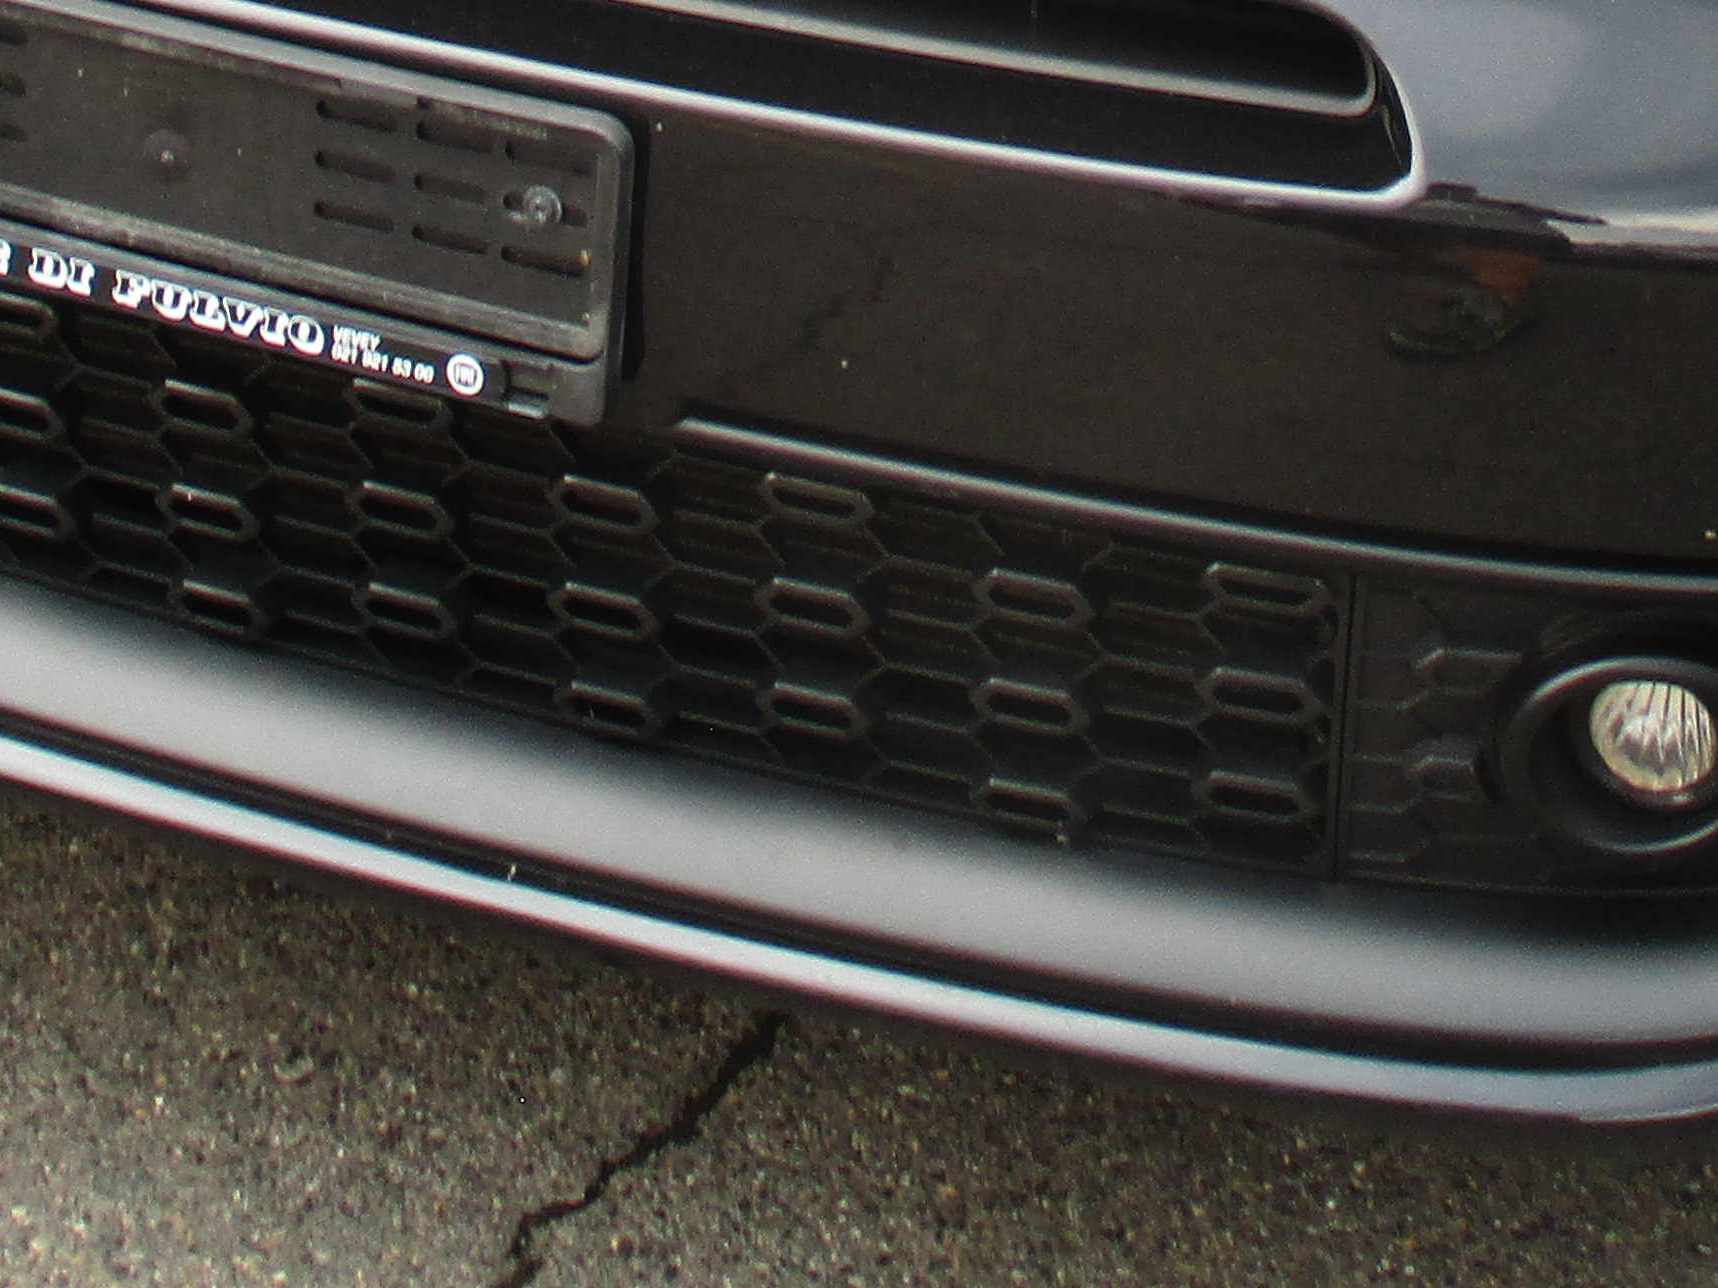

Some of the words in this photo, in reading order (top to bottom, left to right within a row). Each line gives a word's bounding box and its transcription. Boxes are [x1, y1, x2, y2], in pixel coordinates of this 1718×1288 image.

[28, 247, 95, 297] DI
[112, 269, 325, 357] FULVIO
[332, 324, 381, 351] VEVEY
